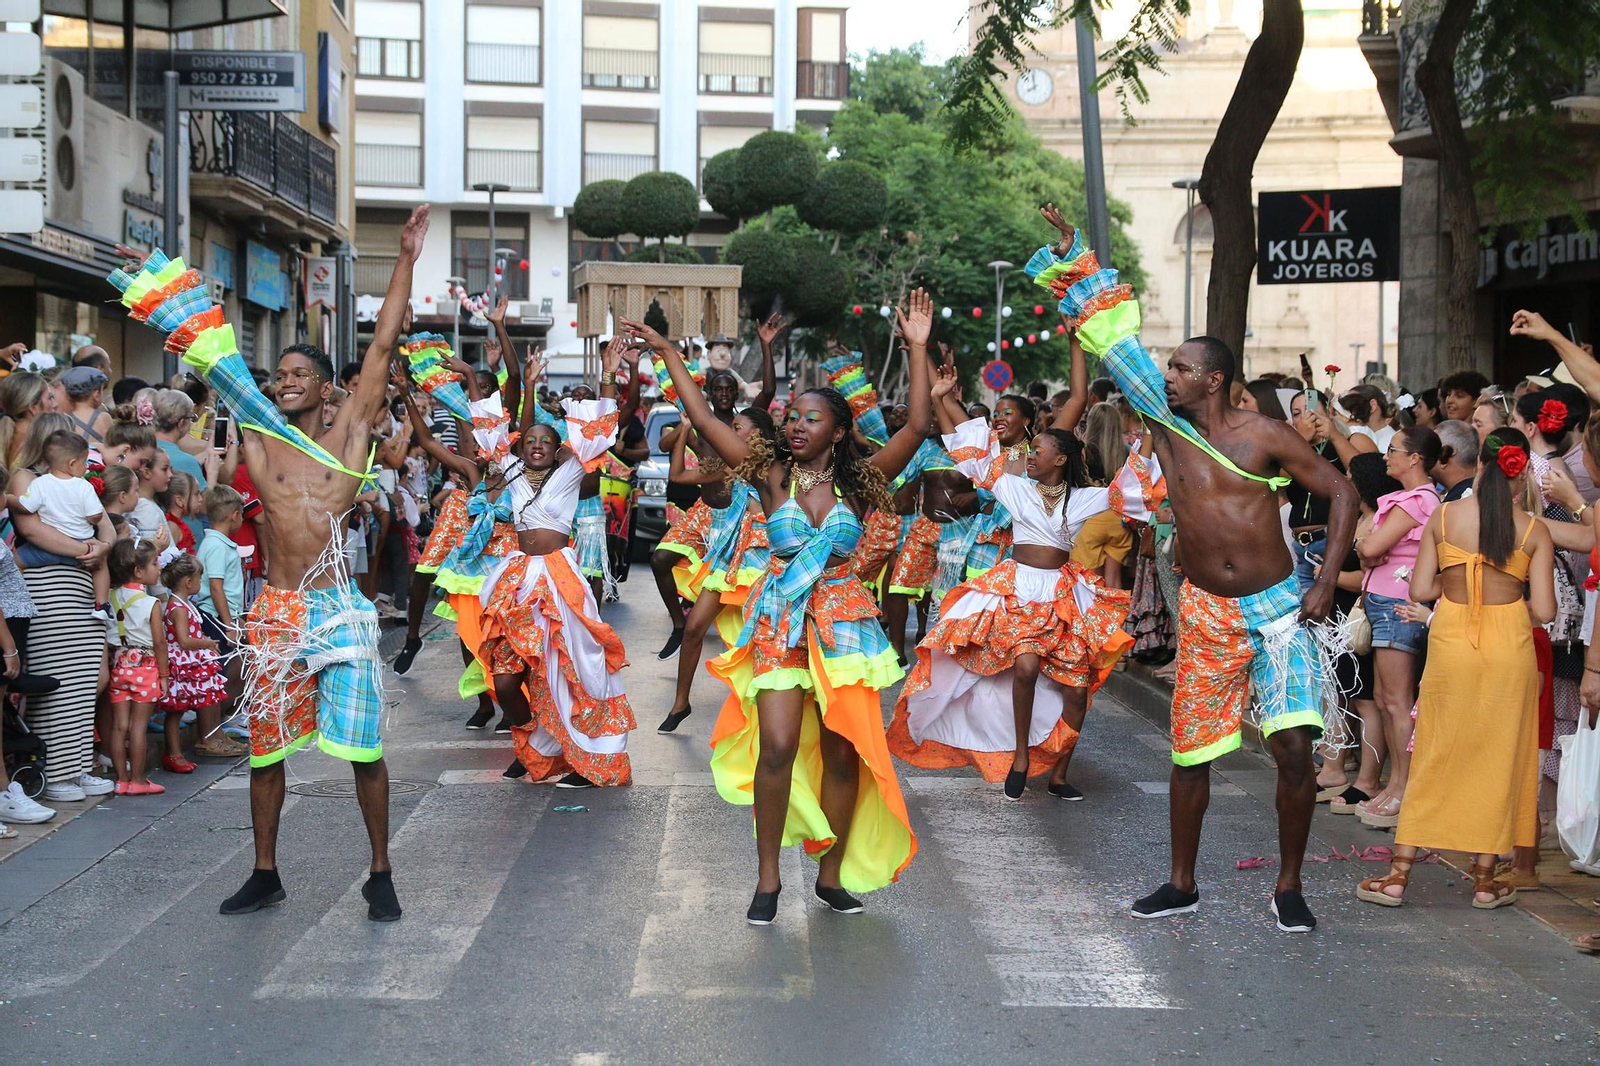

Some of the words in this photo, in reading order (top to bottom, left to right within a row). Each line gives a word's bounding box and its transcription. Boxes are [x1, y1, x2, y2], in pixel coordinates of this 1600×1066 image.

[191, 56, 277, 69] DISPONIBLE
[191, 72, 216, 84] 950
[220, 72, 237, 84] 27
[240, 73, 258, 85] 25
[261, 73, 278, 85] 17
[1268, 237, 1378, 262] KUARA
[1504, 221, 1600, 280] cajam
[1273, 262, 1374, 280] JOYEROS
